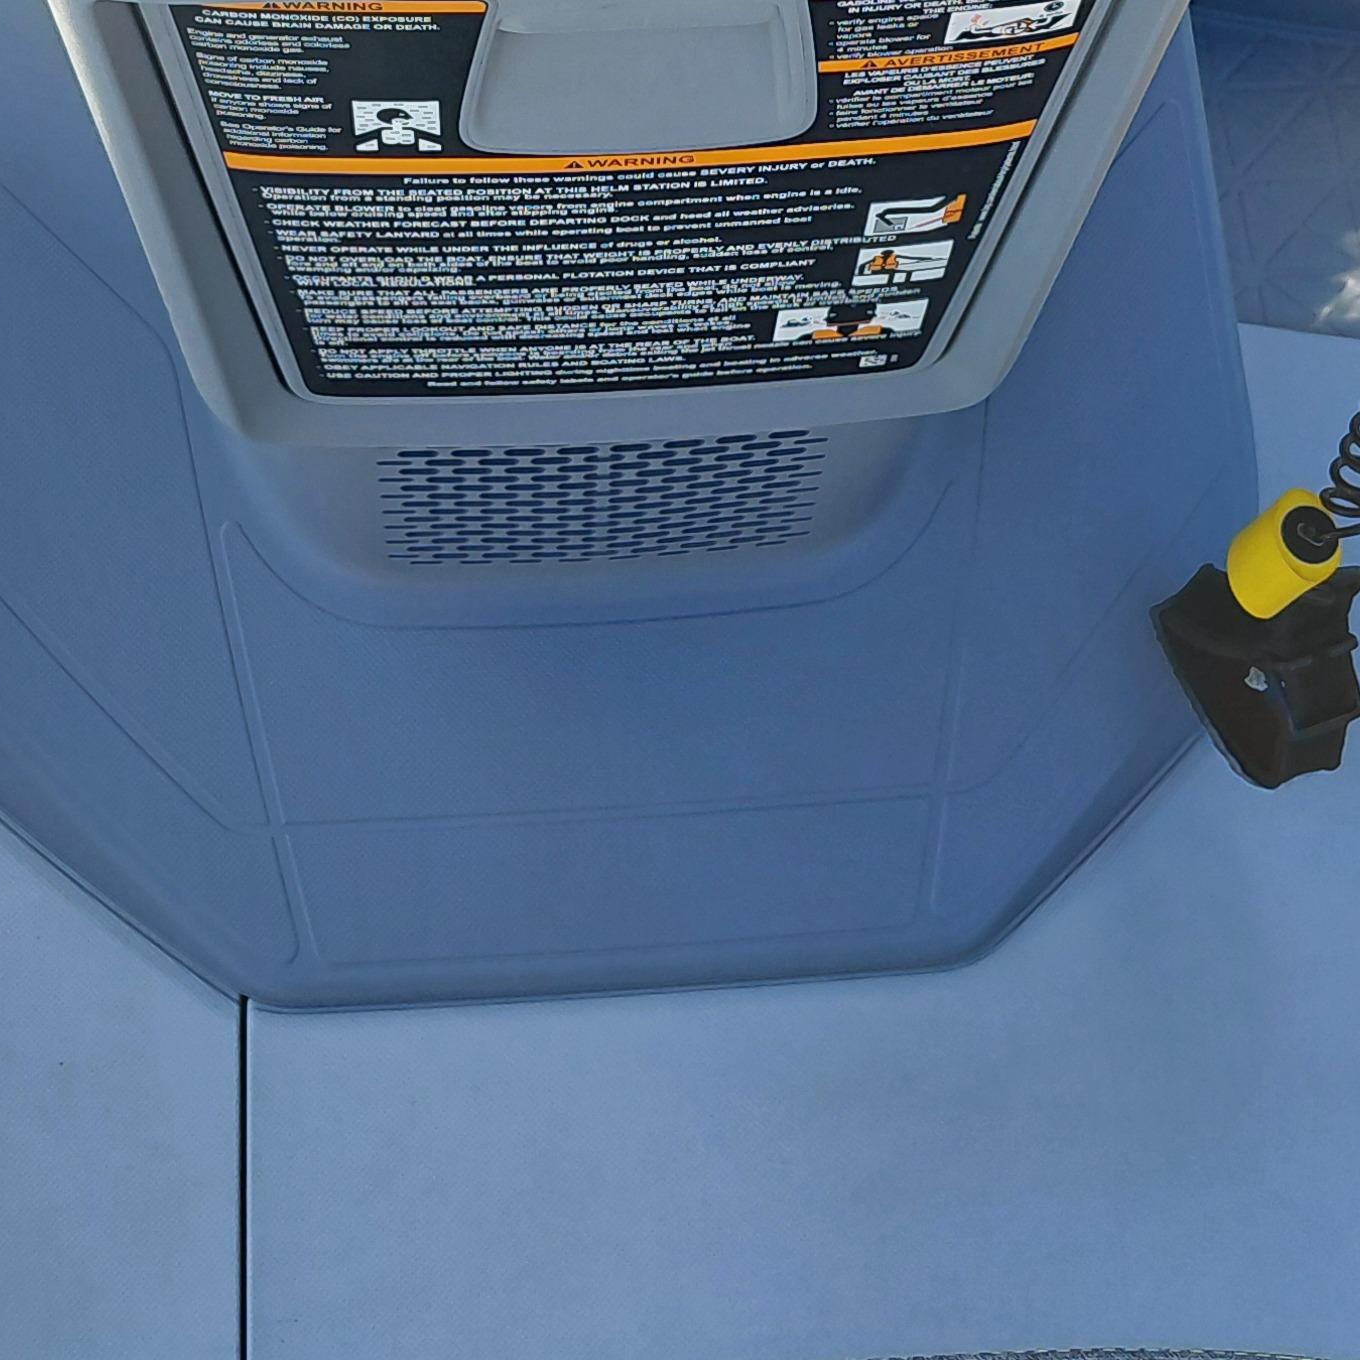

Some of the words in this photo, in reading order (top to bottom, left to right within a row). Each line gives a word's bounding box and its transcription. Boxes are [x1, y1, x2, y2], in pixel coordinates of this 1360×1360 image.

[282, 1, 383, 11] WARNING
[862, 4, 902, 13] INJURY
[202, 9, 257, 19] CARBON
[260, 13, 329, 22] MONOXIDE
[195, 16, 221, 25] CAN
[225, 19, 269, 27] CAUSE
[272, 21, 311, 29] BRAIN
[315, 22, 370, 30] DAMAGE
[884, 42, 1045, 67] AVERTISSEMENT
[208, 90, 242, 99] MOVE
[245, 93, 261, 101] TO
[263, 95, 301, 103] FRESH
[588, 155, 695, 167] WARNING
[403, 177, 450, 185] Failure
[553, 174, 614, 183] warnings
[617, 172, 654, 180] could
[658, 170, 697, 178] cause
[758, 162, 807, 173] INJURY
[828, 158, 876, 168] DEATH.
[260, 186, 330, 196] VISIBILITY
[466, 188, 531, 196] POSITION
[556, 186, 587, 194] THIS
[591, 184, 629, 193] HELM
[633, 181, 690, 191] STATION
[694, 180, 707, 188] IS
[711, 177, 768, 187] LIMITED.
[272, 219, 320, 227] CHECK
[323, 220, 390, 228] WEATHER
[393, 220, 467, 228] FORECAST
[471, 219, 526, 227] BEFORE
[530, 216, 607, 226] DEPARTING
[610, 215, 650, 223] DOCK
[653, 213, 676, 221] and
[680, 211, 711, 219] heed
[714, 210, 730, 218] all
[733, 207, 784, 217] weather
[787, 203, 854, 214] advisories.
[282, 245, 327, 253] NEVER
[522, 242, 596, 251] INFLUENCE
[616, 240, 653, 249] drugs
[673, 237, 722, 245] alcohol.
